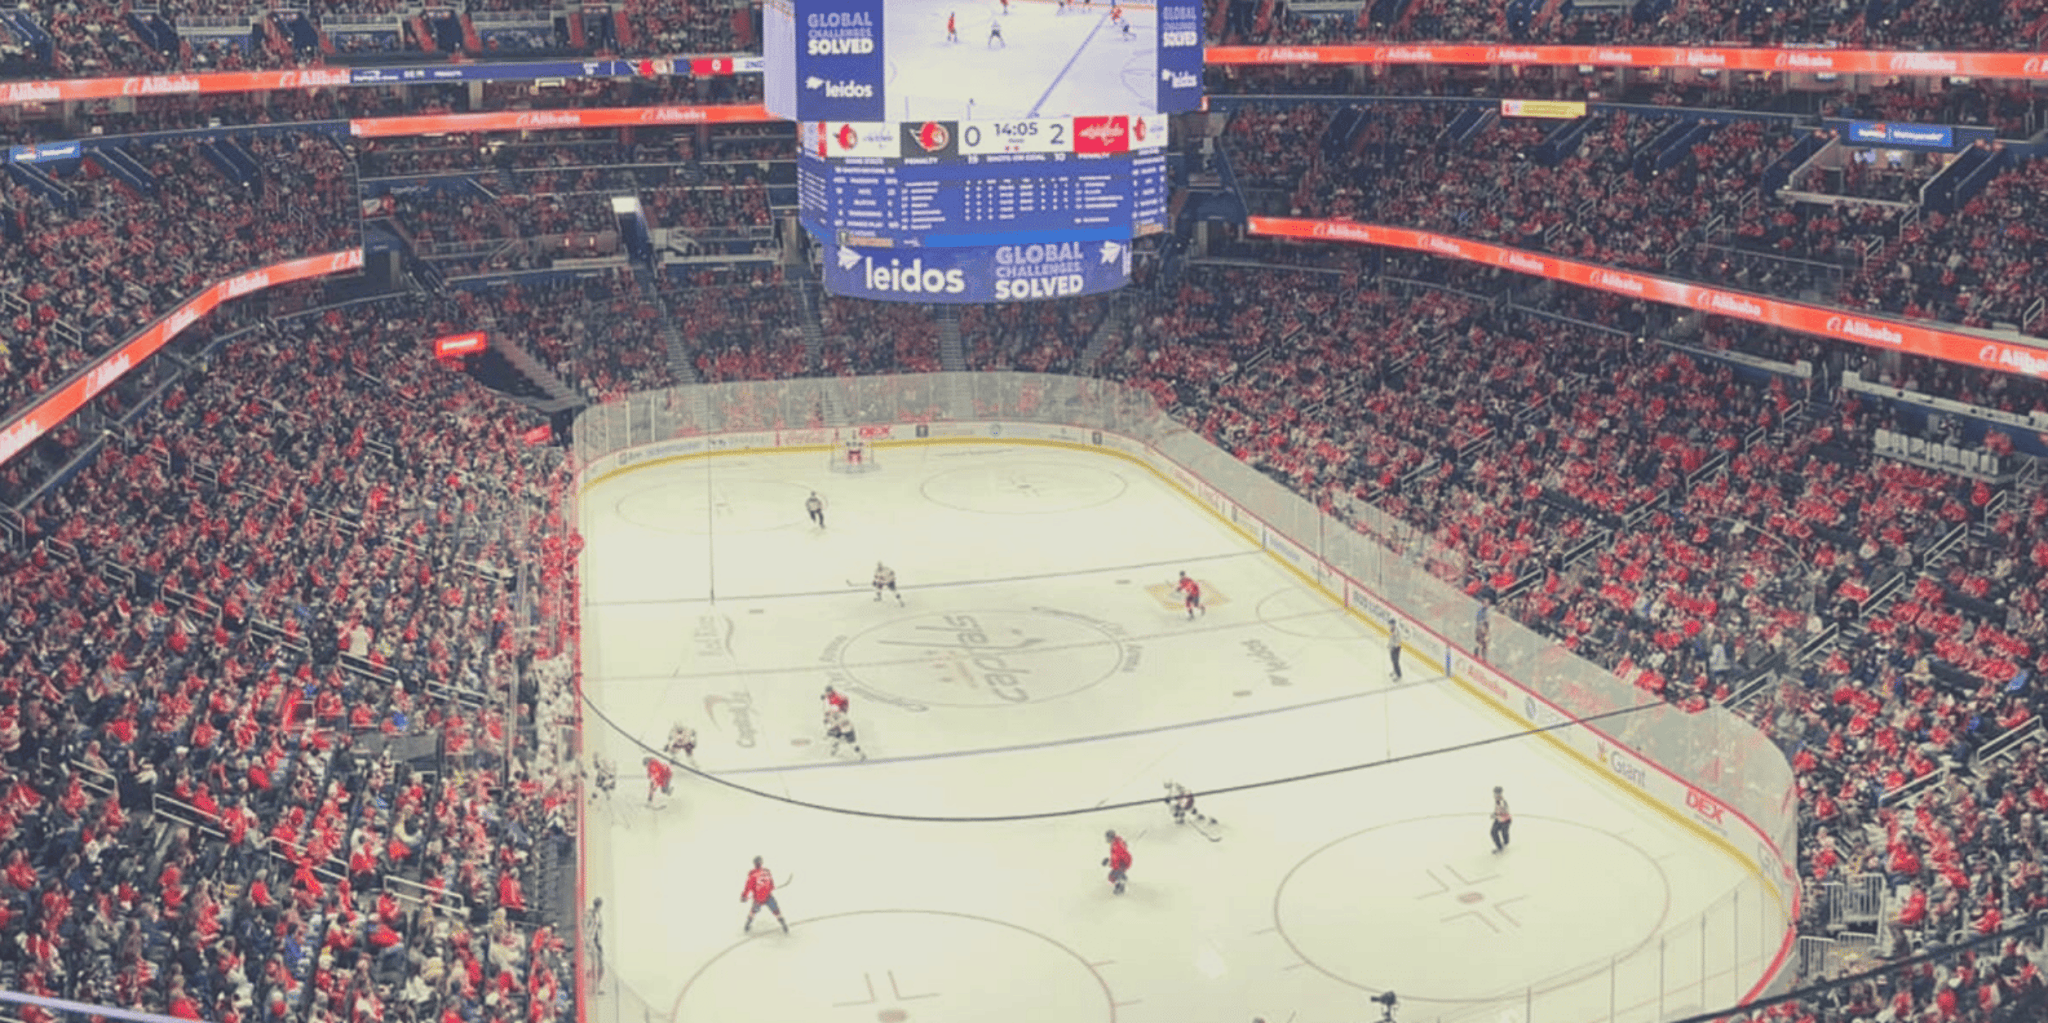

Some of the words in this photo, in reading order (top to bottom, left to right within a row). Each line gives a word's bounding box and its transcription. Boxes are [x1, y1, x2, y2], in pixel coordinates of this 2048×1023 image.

[807, 12, 873, 27] GLOBAL
[807, 39, 874, 55] SOLVED
[1270, 48, 1318, 61] Alibaba
[1388, 47, 1432, 61] Alibaba
[1498, 48, 1539, 61] Alibaba
[1599, 49, 1632, 62] Alibaba
[1687, 51, 1726, 66] Alibaba
[1787, 53, 1833, 69] Alibaba
[1905, 54, 1957, 72] Alibaba
[139, 75, 200, 94] Alibaba
[1171, 70, 1198, 88] leidos
[8, 81, 60, 101] Alibaba
[825, 80, 873, 97] leidos
[530, 112, 580, 125] Alibaba
[656, 107, 707, 121] Alibaba
[964, 125, 981, 147] 0
[993, 121, 1039, 136] 14:05
[1049, 122, 1065, 145] 2
[994, 241, 1084, 266] GLOBAL
[865, 256, 966, 294] leidos
[994, 262, 1083, 279] CHALLENGES
[994, 274, 1084, 301] SOLVED
[1711, 293, 1761, 317] Alibaba
[1842, 318, 1903, 344] Alibaba
[1610, 750, 1646, 788] Giant
[1685, 789, 1724, 825] DEX
